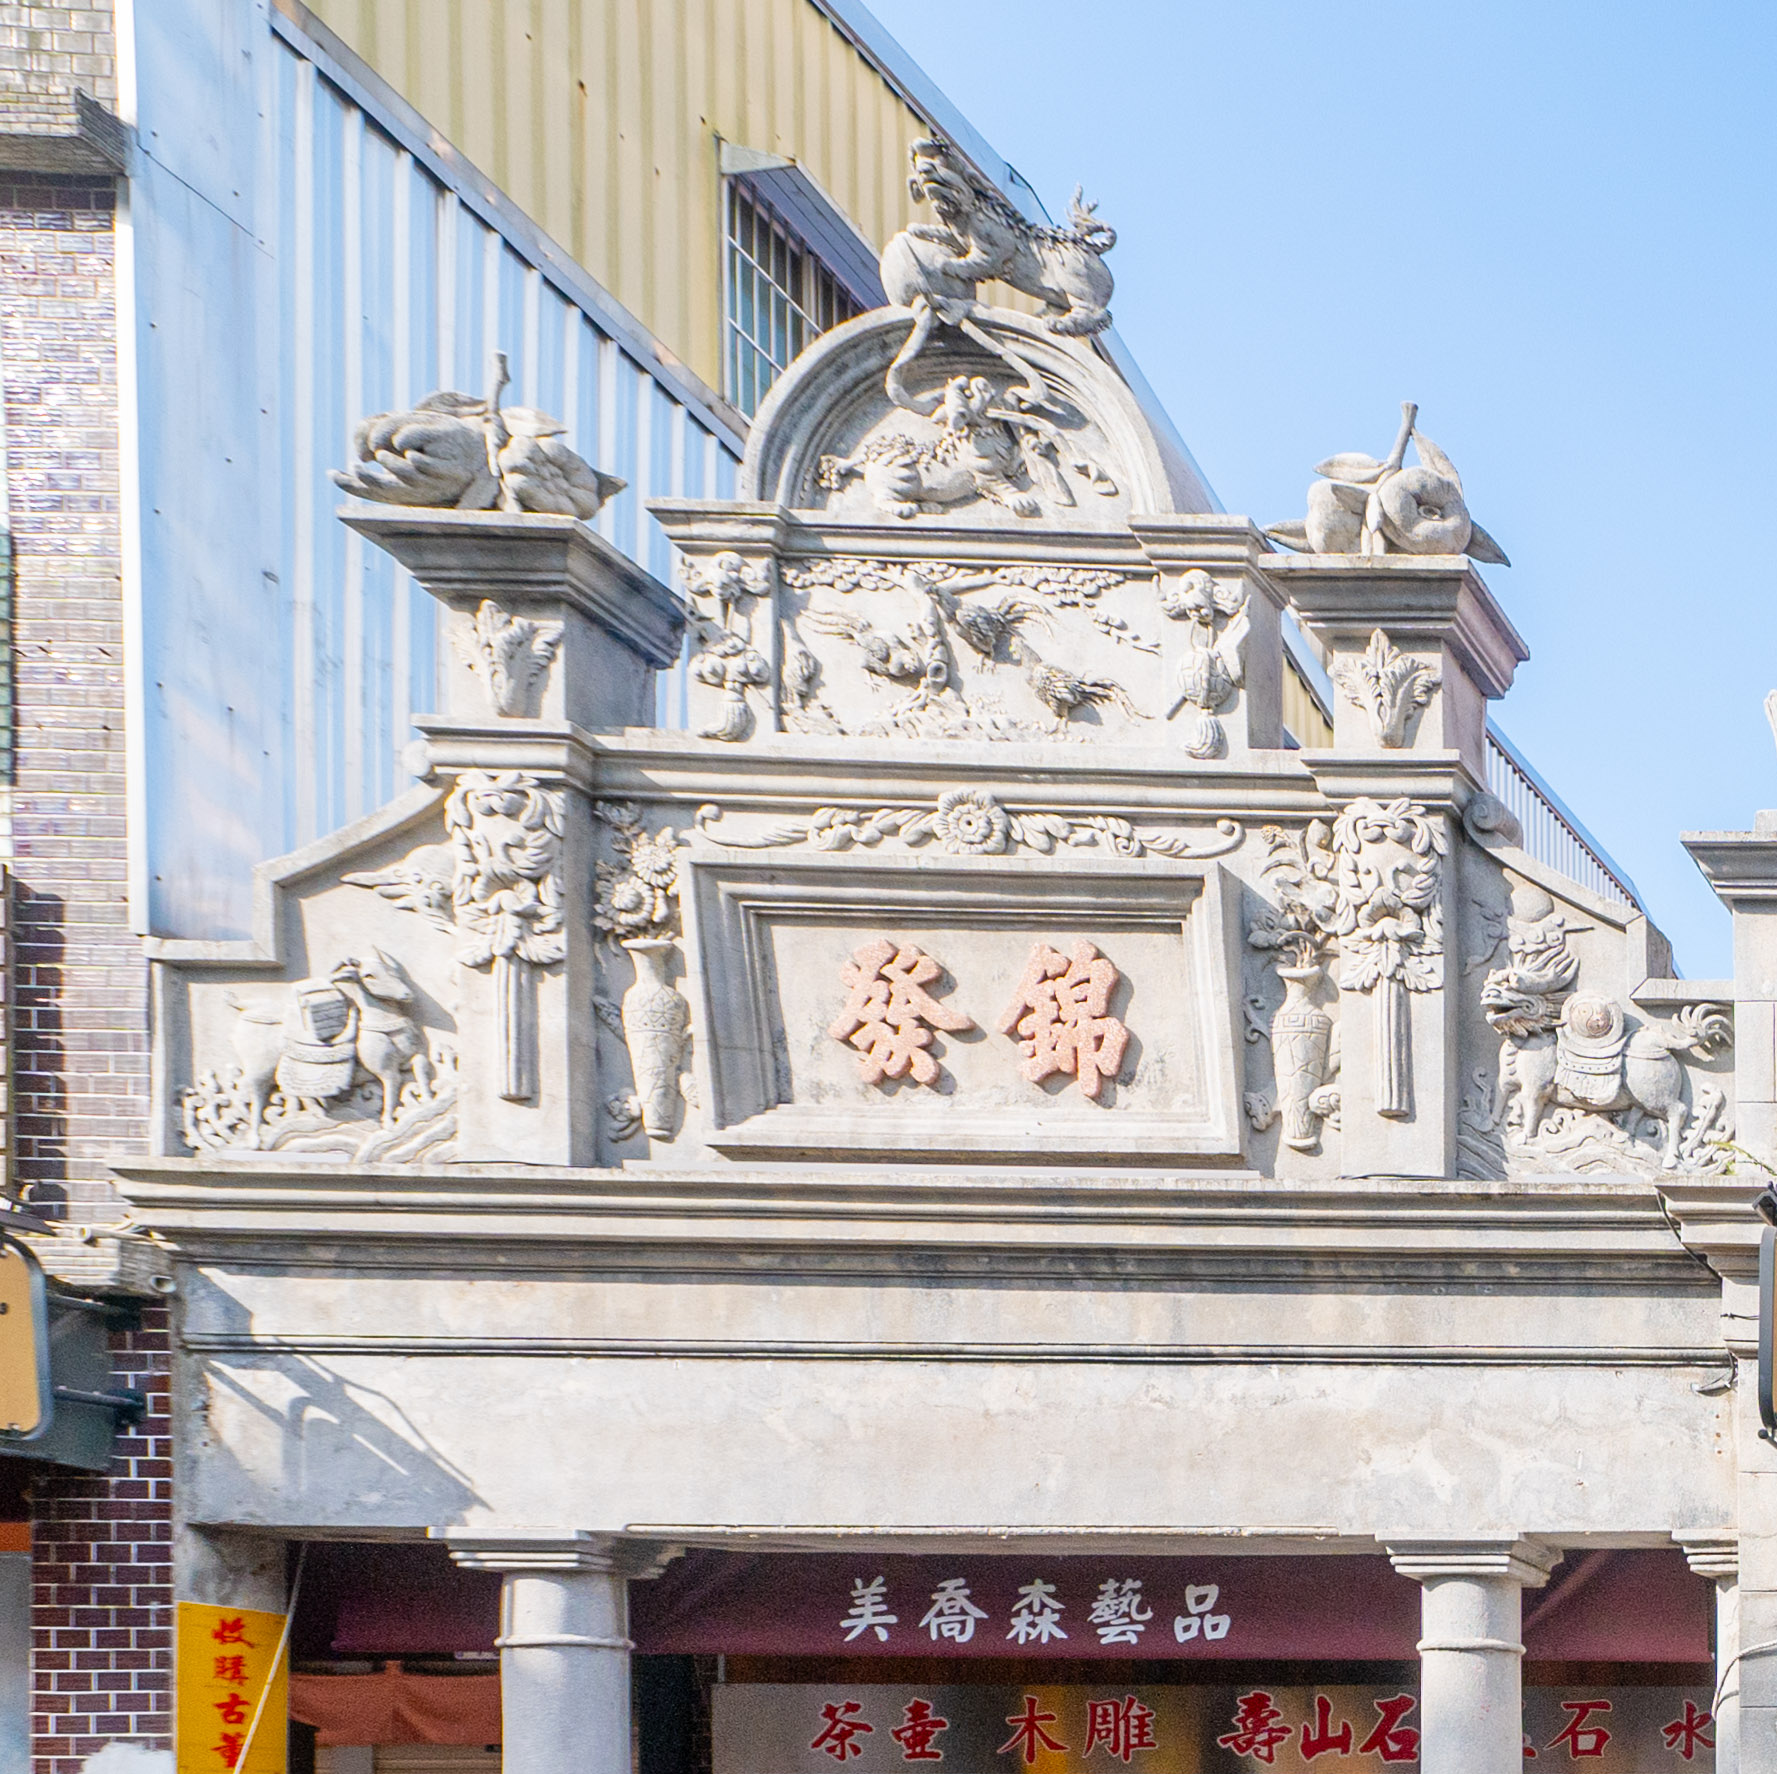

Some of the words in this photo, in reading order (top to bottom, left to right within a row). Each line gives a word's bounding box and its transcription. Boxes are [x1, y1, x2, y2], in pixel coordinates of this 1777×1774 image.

[838, 1575, 1233, 1645] 美喬森藝品
[996, 1694, 1161, 1763] 木雕
[1216, 1689, 1420, 1765] 壽山石
